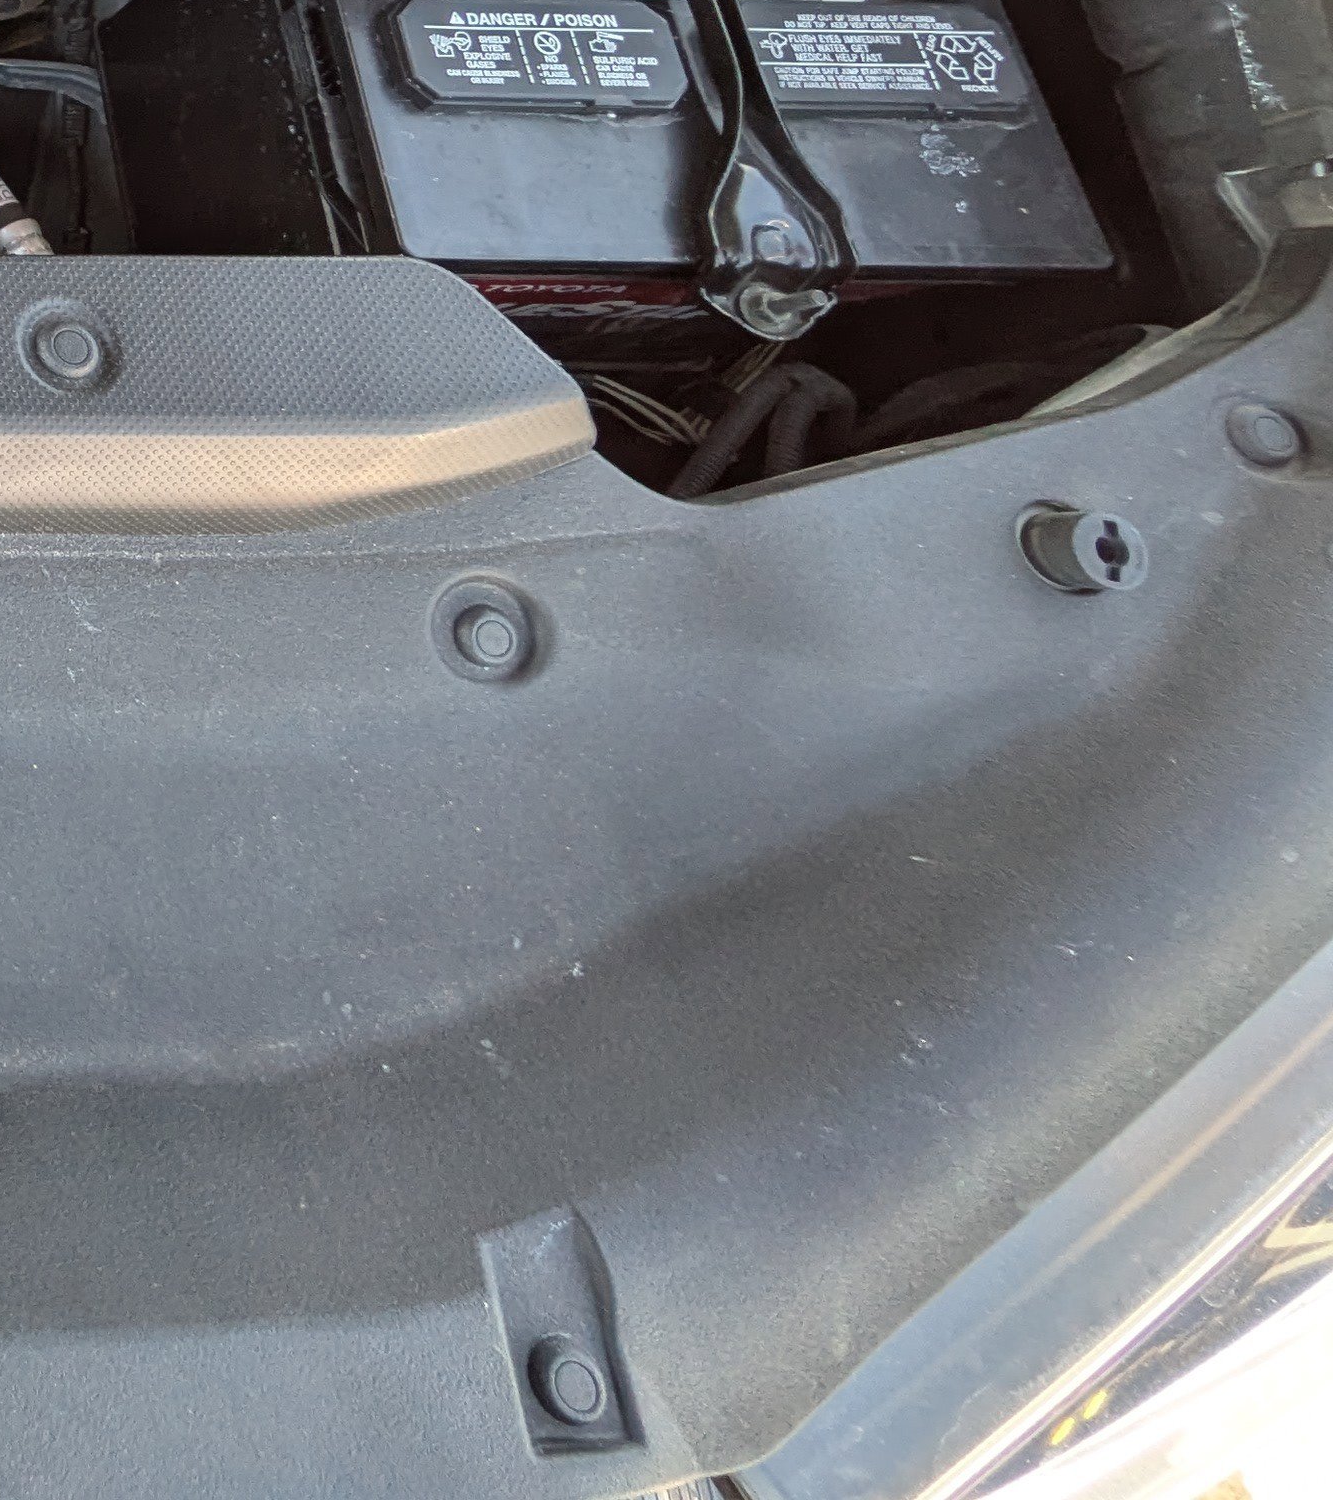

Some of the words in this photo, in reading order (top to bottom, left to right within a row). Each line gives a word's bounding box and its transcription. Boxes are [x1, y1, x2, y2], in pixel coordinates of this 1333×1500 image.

[466, 12, 537, 26] DANGER
[540, 13, 550, 26] /
[553, 13, 619, 28] POISON
[796, 13, 816, 21] KEEP
[478, 35, 511, 43] SHIELD
[787, 34, 817, 43] FLUSH
[817, 34, 842, 44] EYES
[842, 35, 901, 45] IMMEDIATELY
[480, 44, 505, 52] EYES
[790, 43, 816, 53] WITH
[850, 44, 870, 53] GET
[463, 52, 512, 61] EXPLOSIVE
[543, 55, 559, 63] NO
[592, 55, 636, 65] SULFURIC
[637, 56, 659, 66] ACID
[794, 53, 834, 62] MEDICAL
[834, 53, 859, 63] HELP
[859, 53, 883, 63] FAST
[466, 60, 497, 69] GASES
